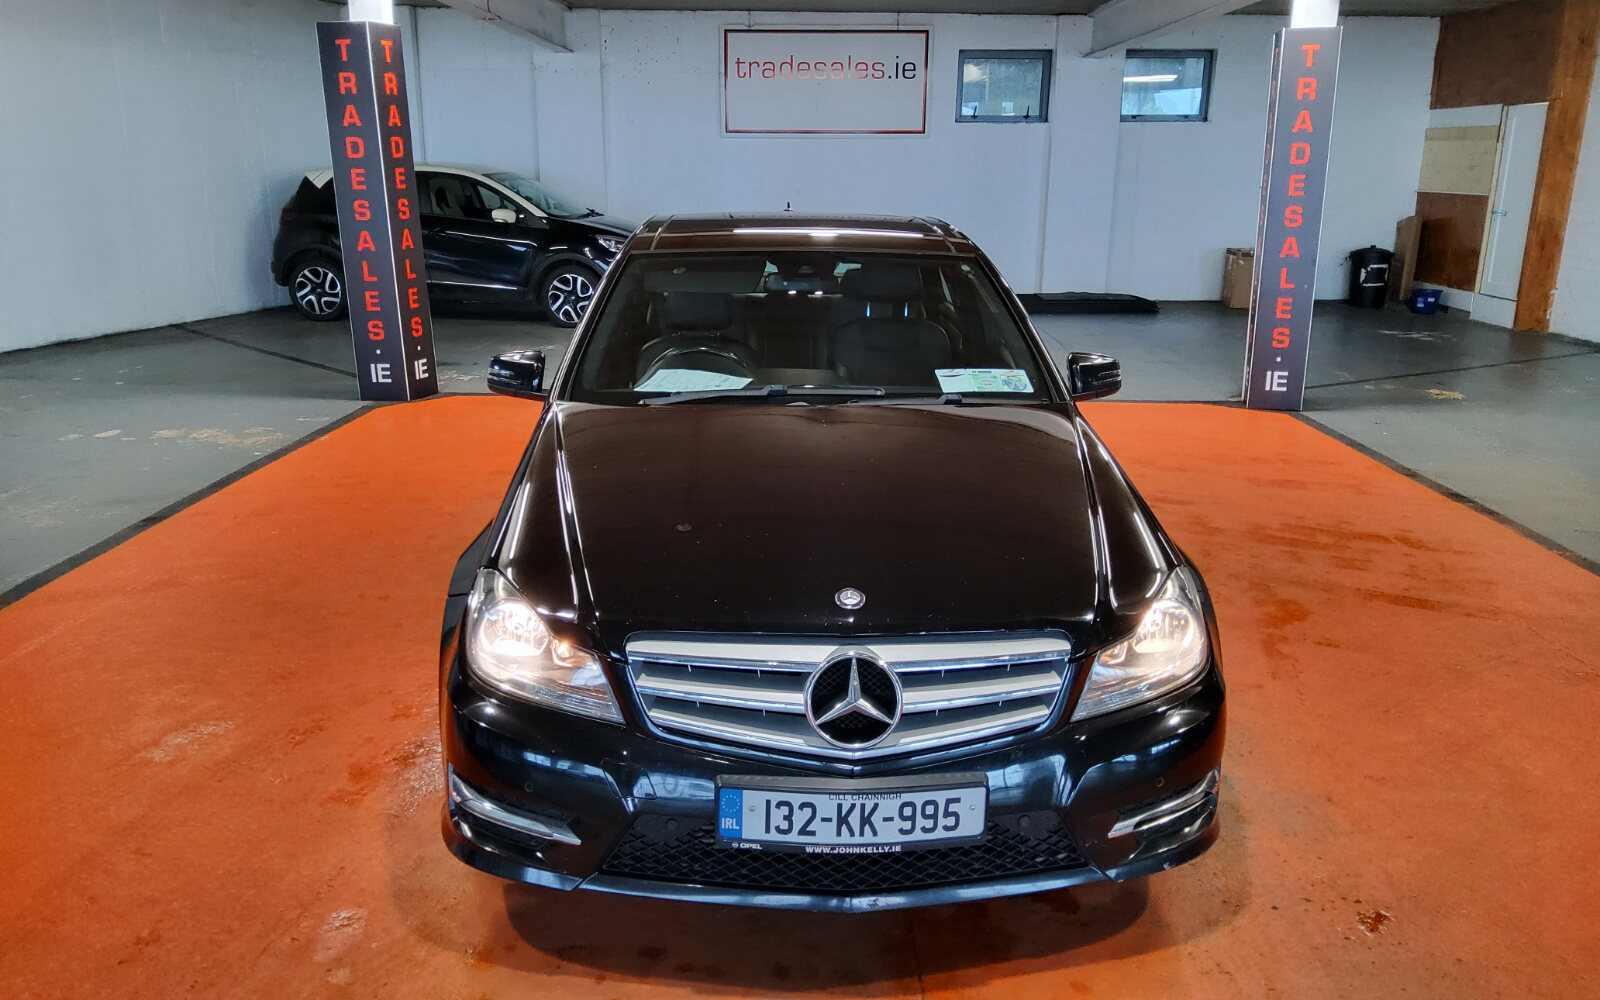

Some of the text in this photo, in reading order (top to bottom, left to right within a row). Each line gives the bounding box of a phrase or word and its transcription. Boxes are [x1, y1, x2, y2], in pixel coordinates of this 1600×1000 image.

[735, 54, 917, 80] tradesales.ie
[828, 793, 902, 801] CILL CHAINNIGH
[764, 796, 962, 838] 132-KK-995
[721, 817, 740, 830] IRL
[740, 842, 763, 850] OPEL
[805, 845, 902, 854] WWW.JOHNKELLY.IE
